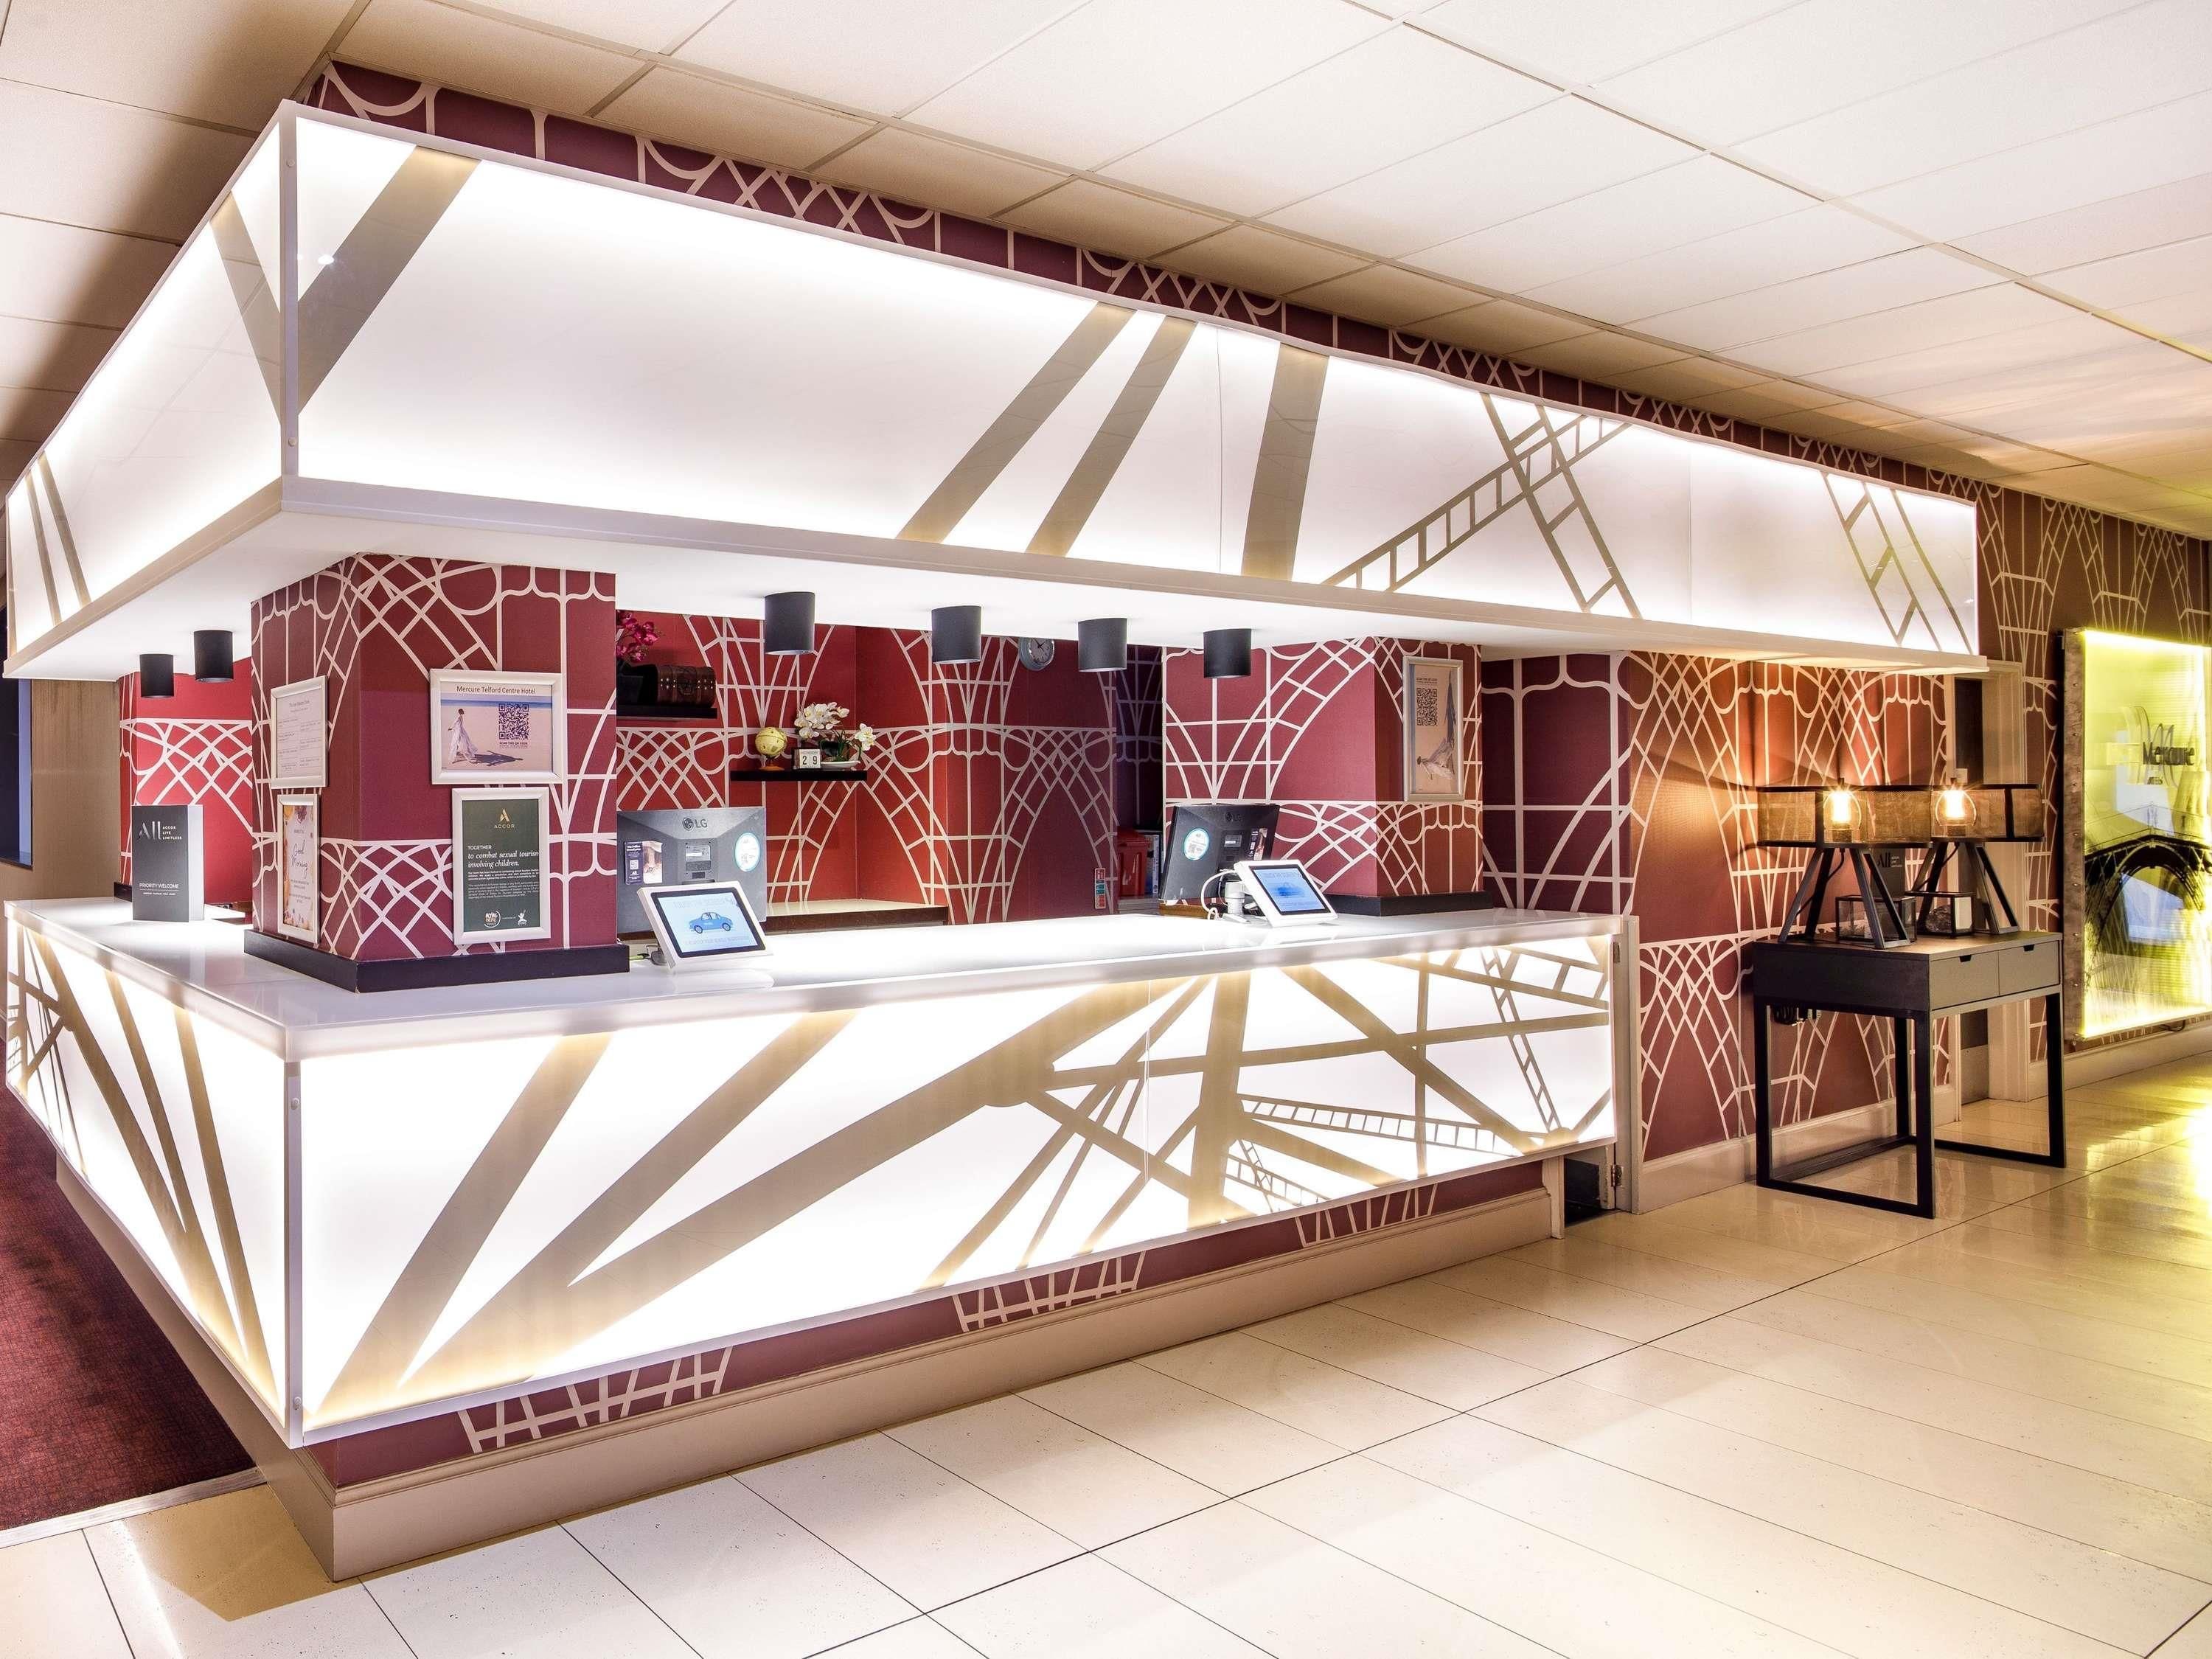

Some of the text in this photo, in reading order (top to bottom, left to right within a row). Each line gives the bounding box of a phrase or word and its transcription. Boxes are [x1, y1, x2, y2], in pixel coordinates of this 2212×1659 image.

[2143, 742, 2195, 765] Mercure
[695, 818, 708, 828] LG
[476, 851, 498, 859] combat
[498, 850, 518, 858] sexual
[468, 859, 520, 869] involving children.
